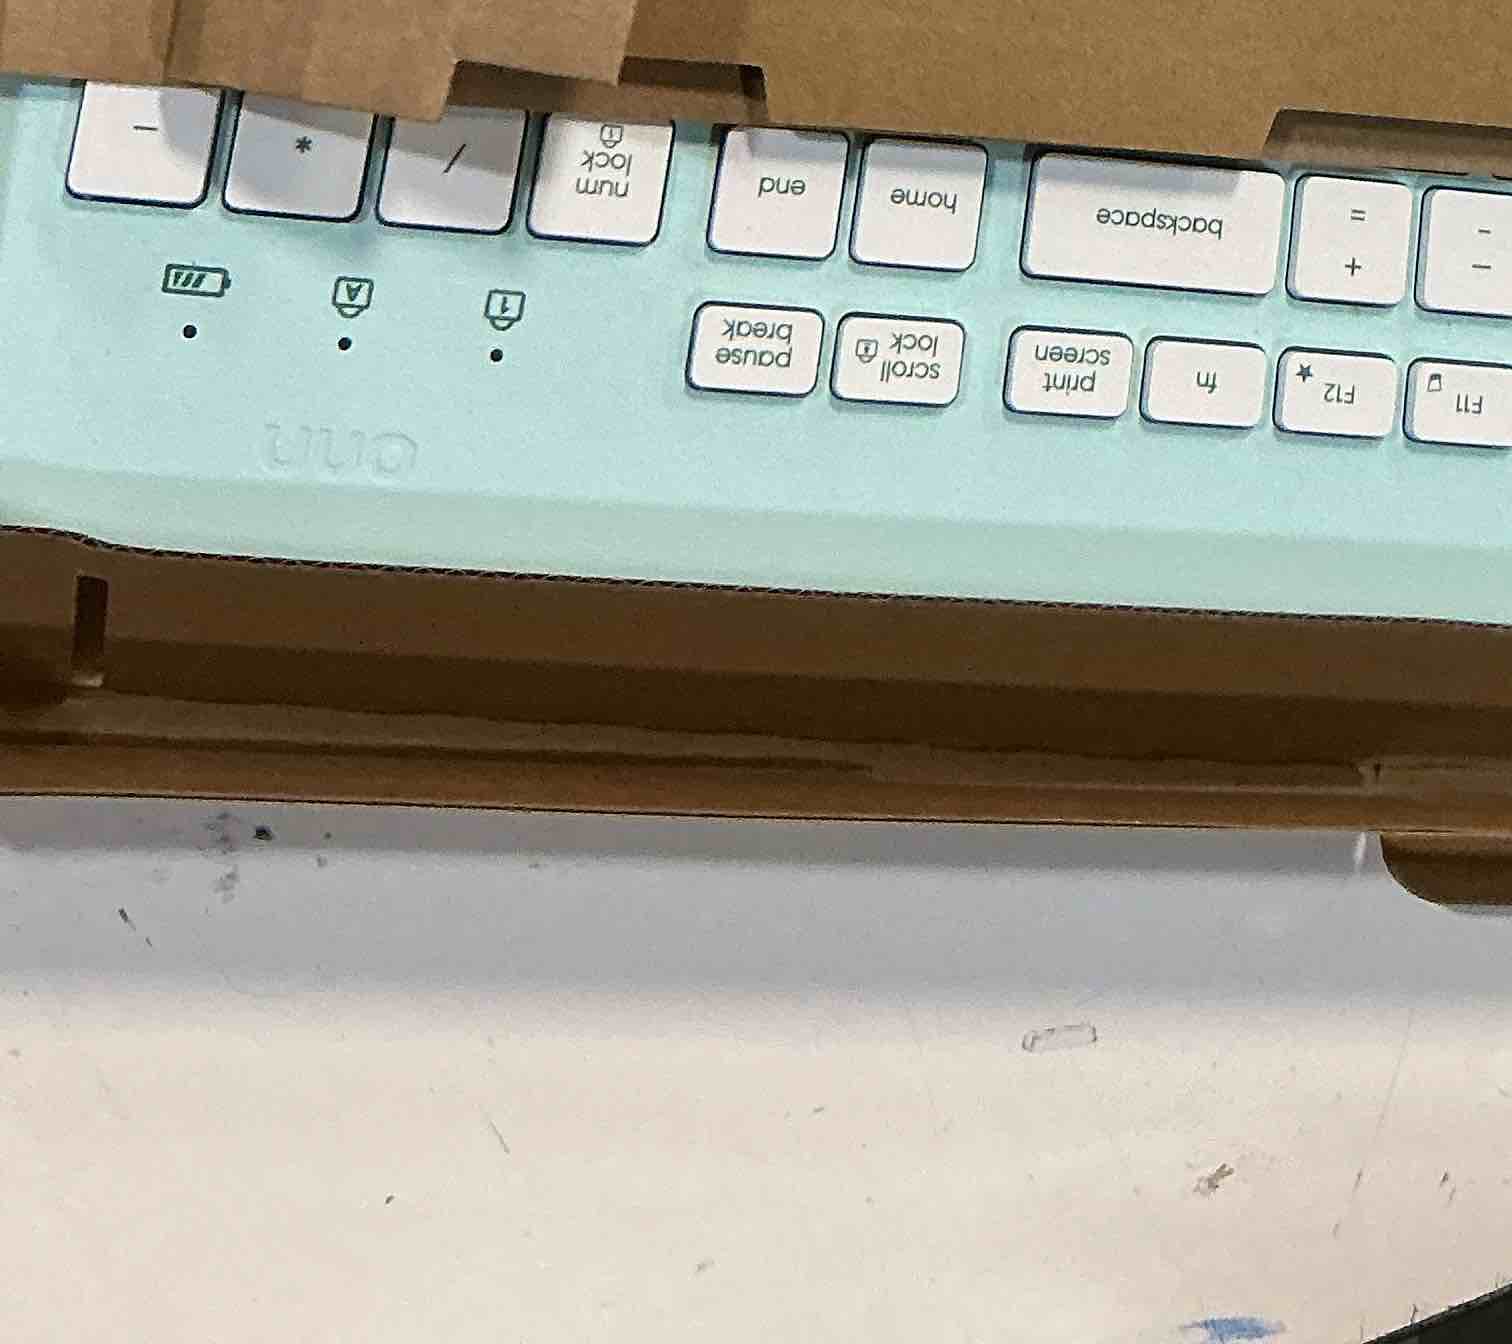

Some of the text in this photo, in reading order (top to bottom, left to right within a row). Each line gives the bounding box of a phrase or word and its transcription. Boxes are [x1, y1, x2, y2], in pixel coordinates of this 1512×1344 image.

[580, 150, 633, 177] lock
[575, 177, 630, 198] num
[757, 176, 806, 198] end
[890, 188, 958, 215] home
[1096, 207, 1223, 241] backspace
[1344, 257, 1362, 277] +
[721, 319, 793, 345] break
[714, 341, 794, 372] pause
[889, 333, 939, 358] lock
[1034, 344, 1111, 366] screen
[879, 360, 941, 383] scroll
[1042, 371, 1097, 393] print
[1196, 371, 1217, 394] fn
[1323, 383, 1355, 405] F12
[1455, 394, 1483, 415] F11
